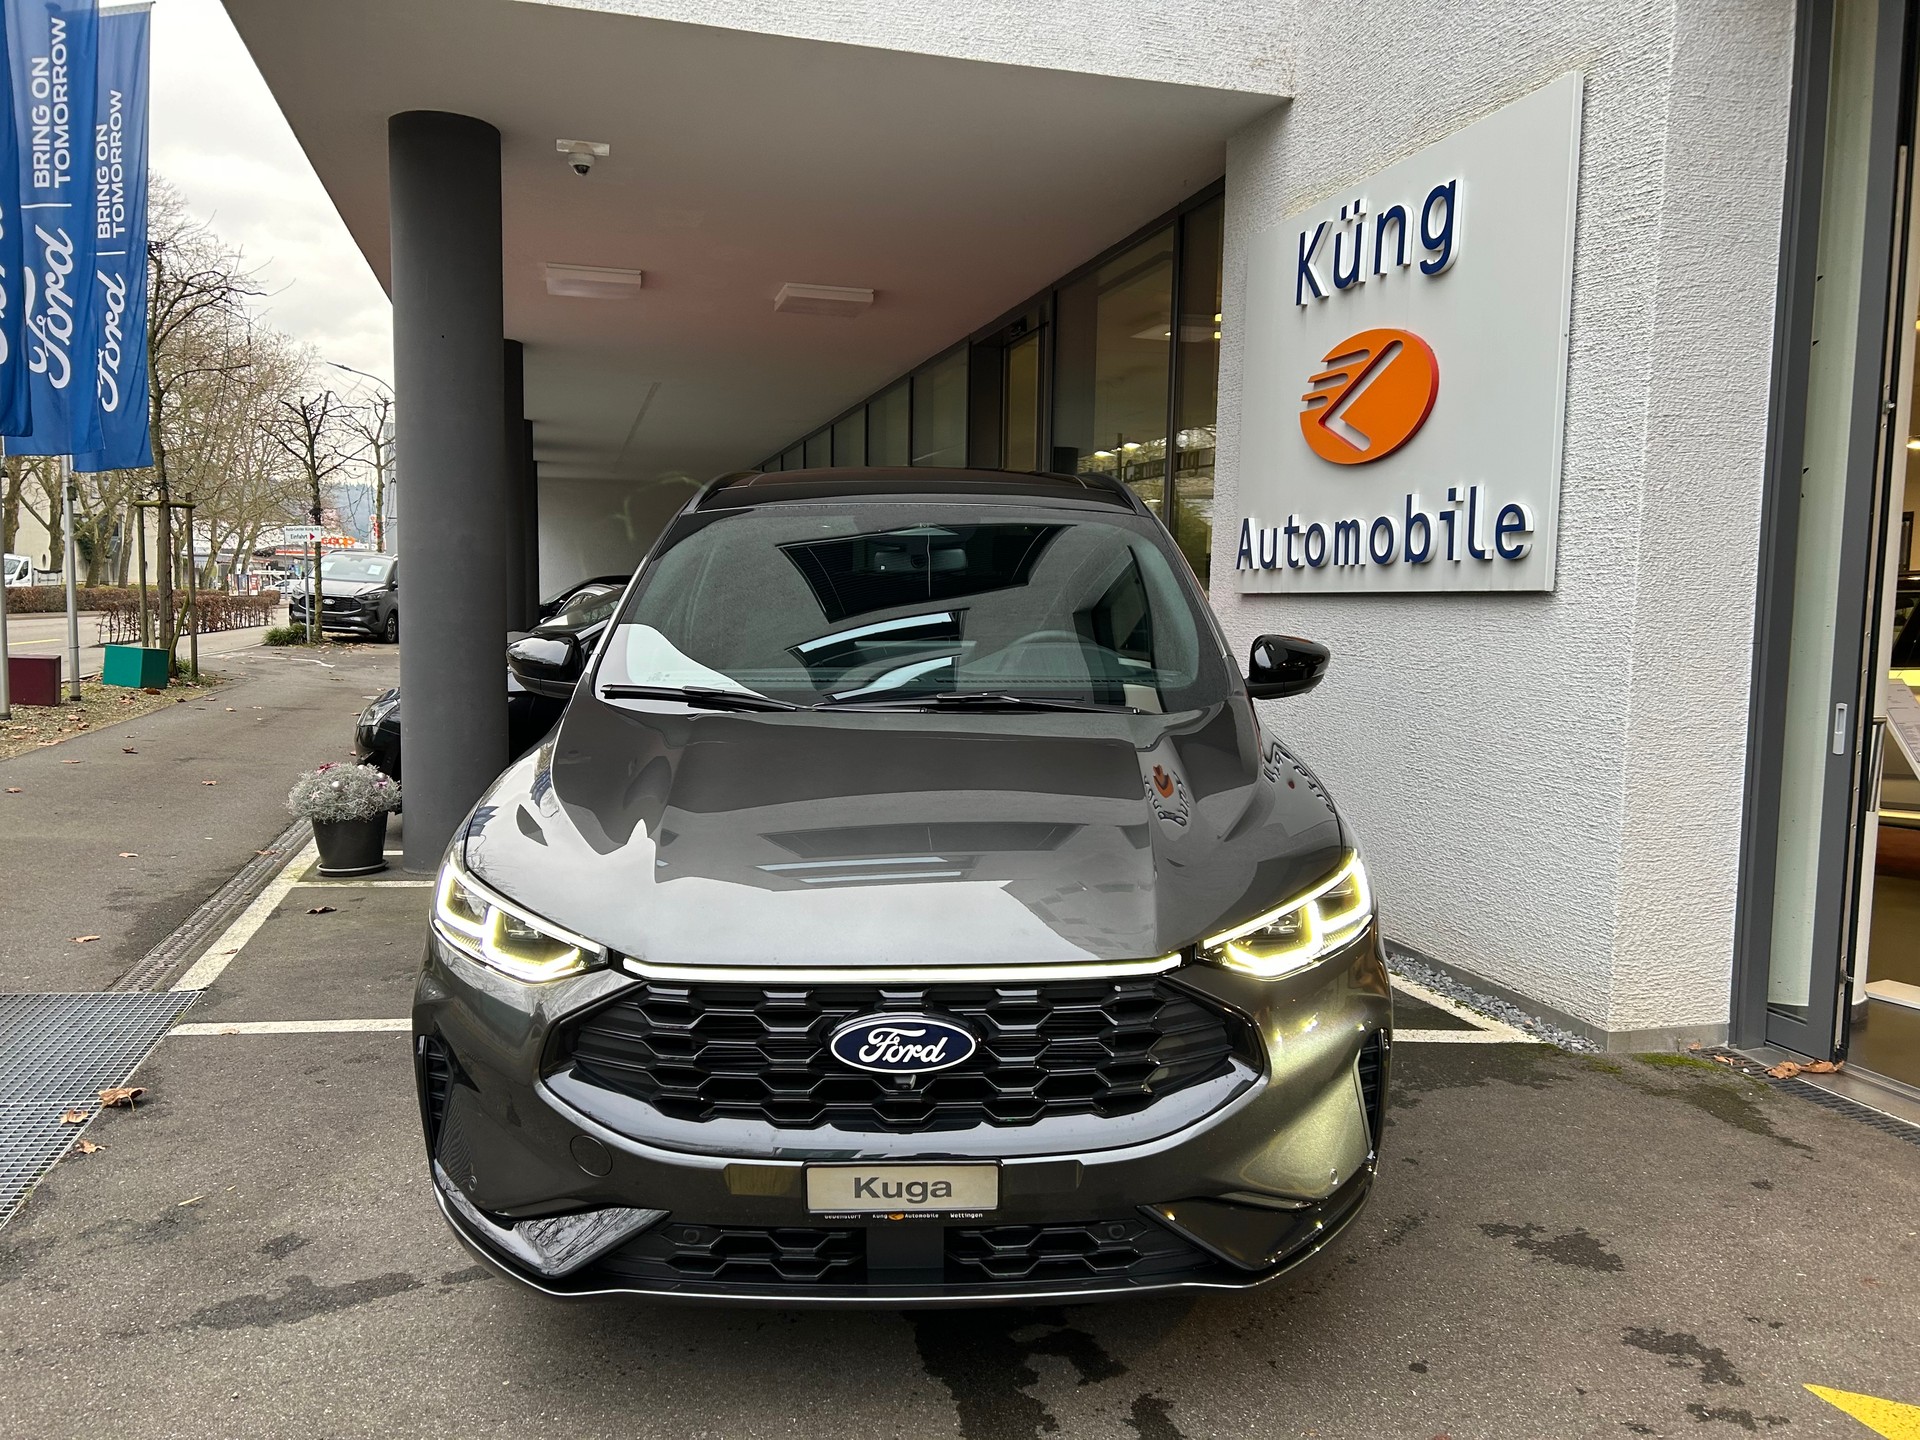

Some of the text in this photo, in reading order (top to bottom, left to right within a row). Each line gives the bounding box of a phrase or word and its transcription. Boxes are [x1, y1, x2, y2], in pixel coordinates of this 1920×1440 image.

[31, 57, 51, 189] BRING ON
[50, 16, 72, 189] TOMORROW
[109, 88, 125, 240] TOMORROW
[96, 123, 110, 240] BRING ON
[1295, 178, 1463, 307] Küng
[24, 225, 74, 390] Ford
[96, 270, 126, 413] Ford
[1236, 485, 1534, 571] Automobile
[858, 1027, 949, 1063] Ford
[853, 1176, 953, 1204] Kuga
